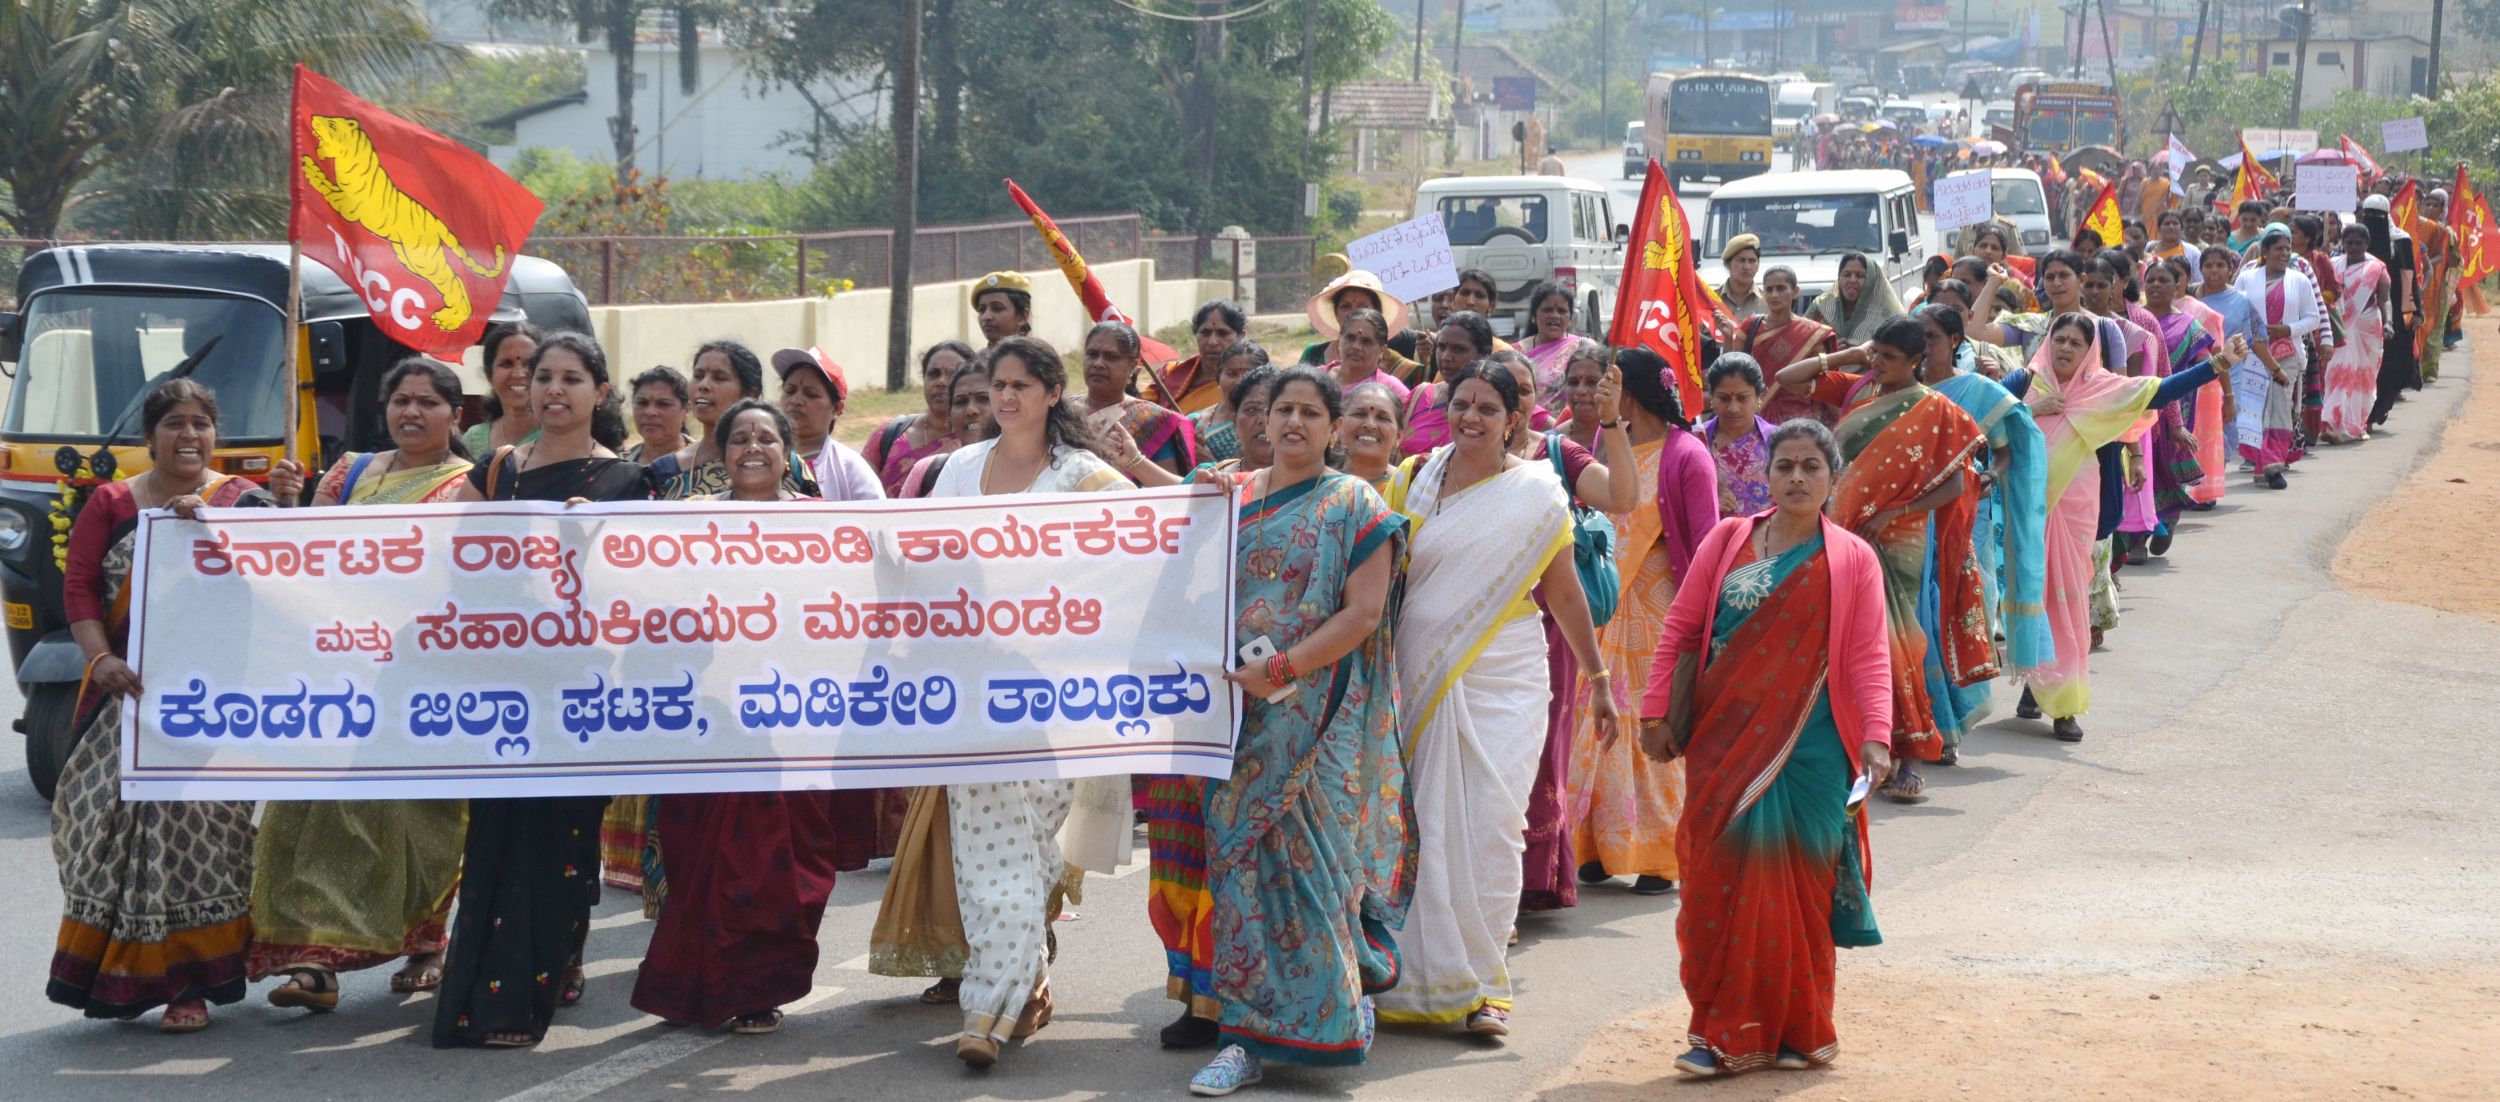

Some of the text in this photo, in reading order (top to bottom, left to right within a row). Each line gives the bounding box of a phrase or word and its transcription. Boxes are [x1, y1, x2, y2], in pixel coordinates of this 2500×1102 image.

[193, 505, 1191, 600] ಕರ್ನಾಟಕ ರಾಜ್ಯ ಅಂಗನವಾಡಿ ಕಾರ್ಯಕರ್ತೆ
[315, 584, 1103, 662] ಮತ್ತು ಸಹಾಯಕೀಯರ ಮಹಾಮಂಡಳಿ
[159, 660, 1212, 757] ಕೊಡಗು ಜಿಲ್ಲಾ ಘಟಕ, ಮಡಿಕೇರಿ ತಾಲ್ಲೂಕು
